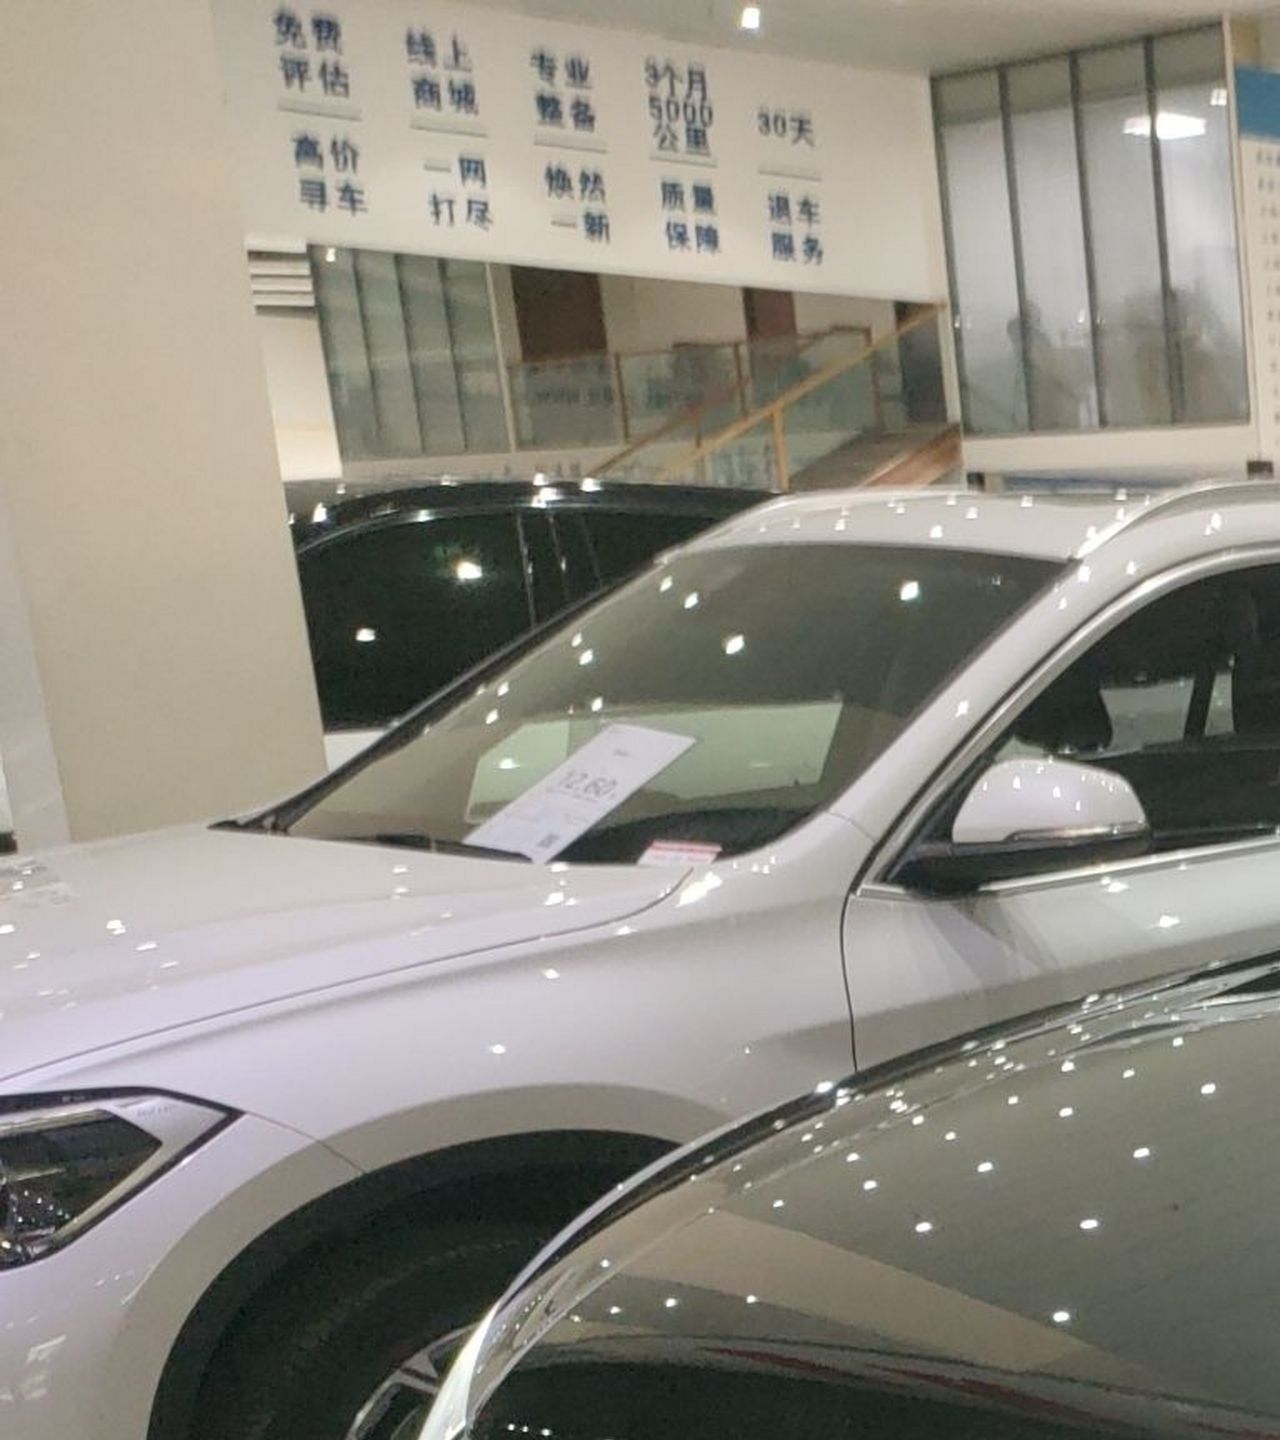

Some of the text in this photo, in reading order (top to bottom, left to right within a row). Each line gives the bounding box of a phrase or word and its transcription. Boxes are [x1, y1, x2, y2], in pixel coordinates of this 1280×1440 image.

[273, 8, 342, 54] 免费
[406, 28, 472, 72] 线上
[279, 54, 349, 98] 评估
[531, 50, 592, 88] 专业
[645, 57, 707, 102] 3个月
[411, 74, 478, 115] 商城
[535, 91, 595, 132] 整备
[649, 95, 713, 128] 5000
[653, 122, 710, 157] 公里
[757, 108, 815, 147] 30天
[291, 132, 359, 173] 高价
[545, 162, 606, 202] 焕然
[661, 180, 716, 215] 质量
[429, 192, 493, 231] 打尽
[767, 188, 821, 226] 退车
[667, 218, 720, 254] 保障
[772, 230, 823, 266] 服务
